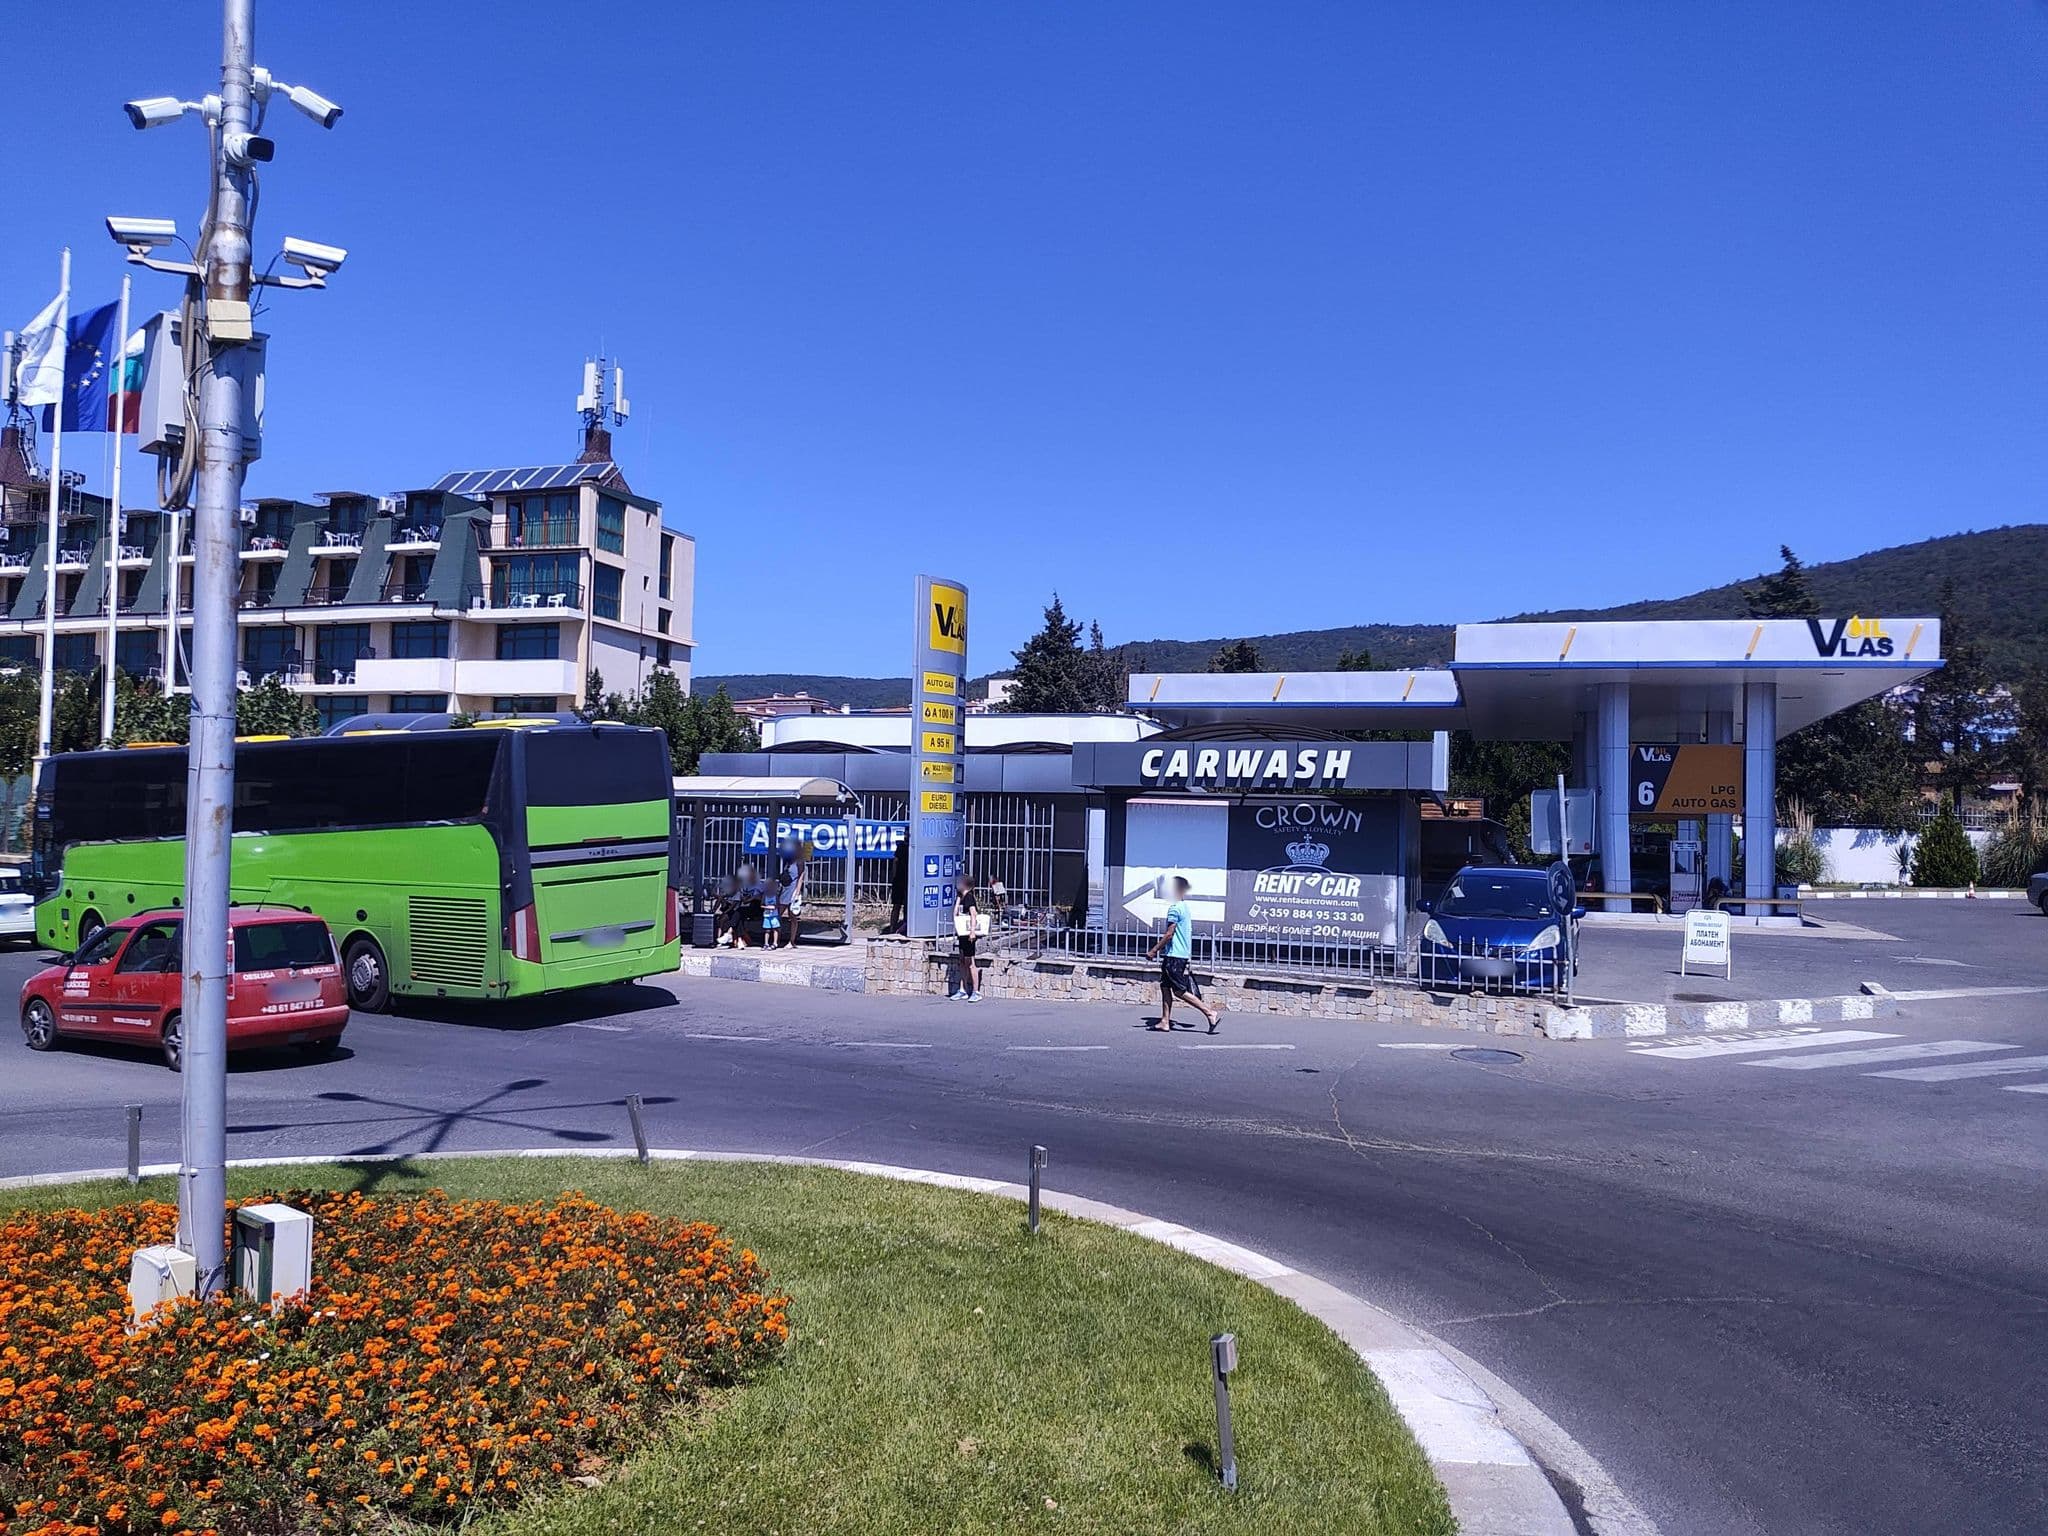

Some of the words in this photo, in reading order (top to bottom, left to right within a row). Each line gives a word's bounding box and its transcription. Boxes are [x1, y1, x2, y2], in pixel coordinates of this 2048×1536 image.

[1806, 619, 1894, 657] VLAS
[926, 679, 943, 688] AUTO
[944, 680, 954, 689] GAS
[939, 708, 949, 719] 100
[937, 737, 944, 748] 95
[1640, 747, 1671, 761] VLAS
[1141, 749, 1352, 779] CARWASH
[1638, 781, 1655, 806] 6
[1711, 786, 1736, 795] LPG
[931, 794, 947, 802] EURO
[1672, 798, 1706, 808] AUTO
[1711, 799, 1736, 808] GAS
[929, 802, 948, 810] DIESEL
[1256, 803, 1363, 833] CROWN
[1274, 826, 1300, 835] SAFETY
[1309, 826, 1344, 837] LOYALTY
[925, 886, 938, 895] ATM
[1253, 874, 1305, 894] RENT
[1320, 876, 1361, 898] CAR
[1255, 896, 1359, 907] www.rentacarcrown.com
[1261, 908, 1290, 918] +359
[1292, 909, 1313, 919] 884
[1316, 910, 1330, 920] 95
[1333, 911, 1347, 921] 33
[1350, 912, 1364, 922] 30
[1313, 925, 1340, 937] 200
[1341, 929, 1380, 940] МАШИН
[1696, 930, 1719, 939] ПЛАТЕН
[1690, 939, 1724, 948] АБОНАМЕНТ
